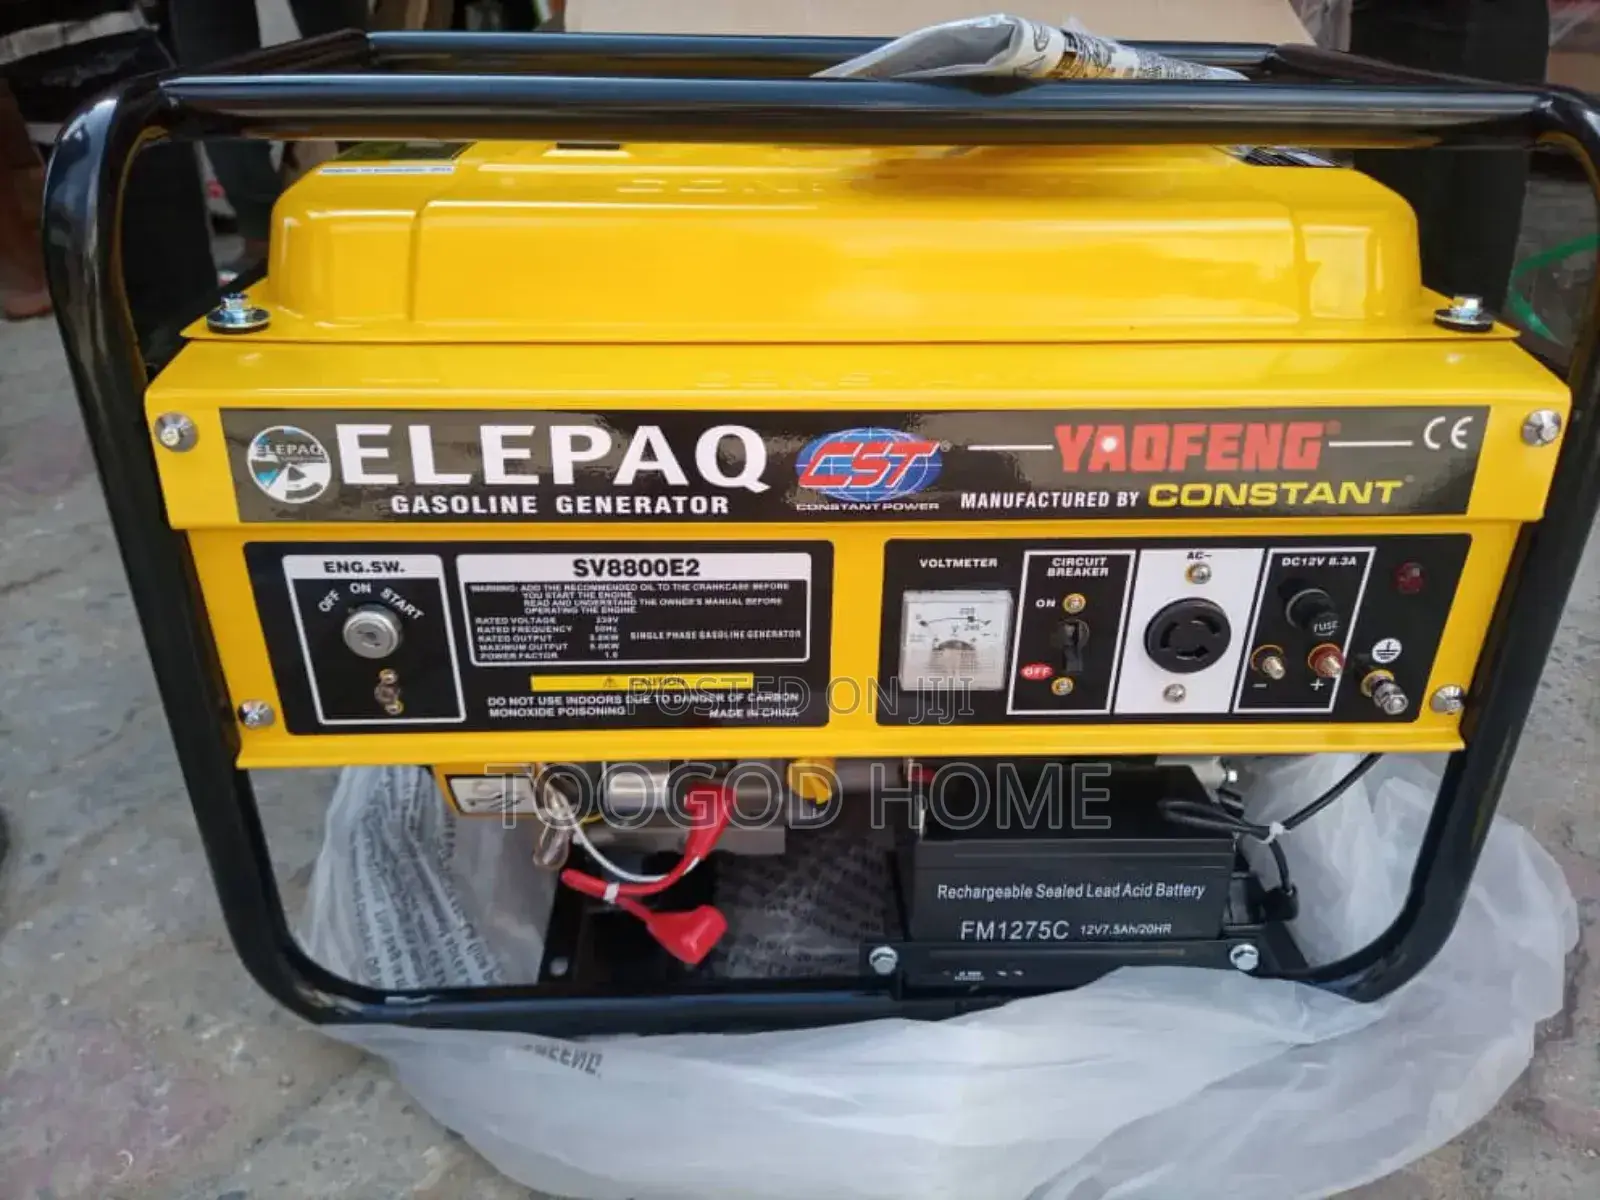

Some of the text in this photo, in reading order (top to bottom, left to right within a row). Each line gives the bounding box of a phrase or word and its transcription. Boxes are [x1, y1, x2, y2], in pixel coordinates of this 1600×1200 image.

[255, 443, 326, 456] ELEPAQ
[1054, 421, 1324, 472] YAOFENG
[336, 424, 770, 493] ELEPAQ
[798, 442, 940, 488] CST
[960, 481, 1403, 509] MANUFACTURED BY CONSTANT
[391, 495, 729, 515] GASOLINE GENERATOR
[796, 502, 940, 511] CONSTANT POWER
[323, 560, 406, 574] ENG.SW.
[573, 558, 700, 577] SV8800E2
[919, 557, 998, 569] VOLTMETER
[1051, 556, 1108, 567] CIRCUIT
[1281, 556, 1326, 567] DC12V
[1046, 567, 1109, 577] BREAKER
[349, 582, 372, 594] ON
[520, 584, 541, 592] ADD
[544, 584, 561, 592] THE
[658, 583, 670, 591] TO
[672, 583, 691, 591] THE
[317, 588, 340, 613] OFF
[379, 586, 425, 620] START
[523, 599, 550, 607] READ
[639, 598, 657, 606] THE
[704, 598, 743, 606] MANUAL
[1035, 598, 1056, 608] ON
[475, 617, 508, 625] RATED
[1313, 620, 1339, 632] FUSE
[630, 629, 802, 640] SINGLE PHASE GASOLINE GENERATOR
[528, 643, 569, 651] OUTPUT
[1022, 666, 1050, 677] OFF
[487, 696, 507, 707] DO
[509, 696, 534, 706] NOT
[537, 696, 562, 706] USE
[565, 695, 622, 705] INDOORS
[625, 694, 652, 705] DUE
[489, 706, 626, 718] MONOXIDE POISONING
[709, 708, 743, 719] MADE
[937, 882, 1206, 903] Rechargeable Sealed Lead Acid Battery
[960, 920, 1172, 940] FM1275C 12V7.5Ah/20HR
